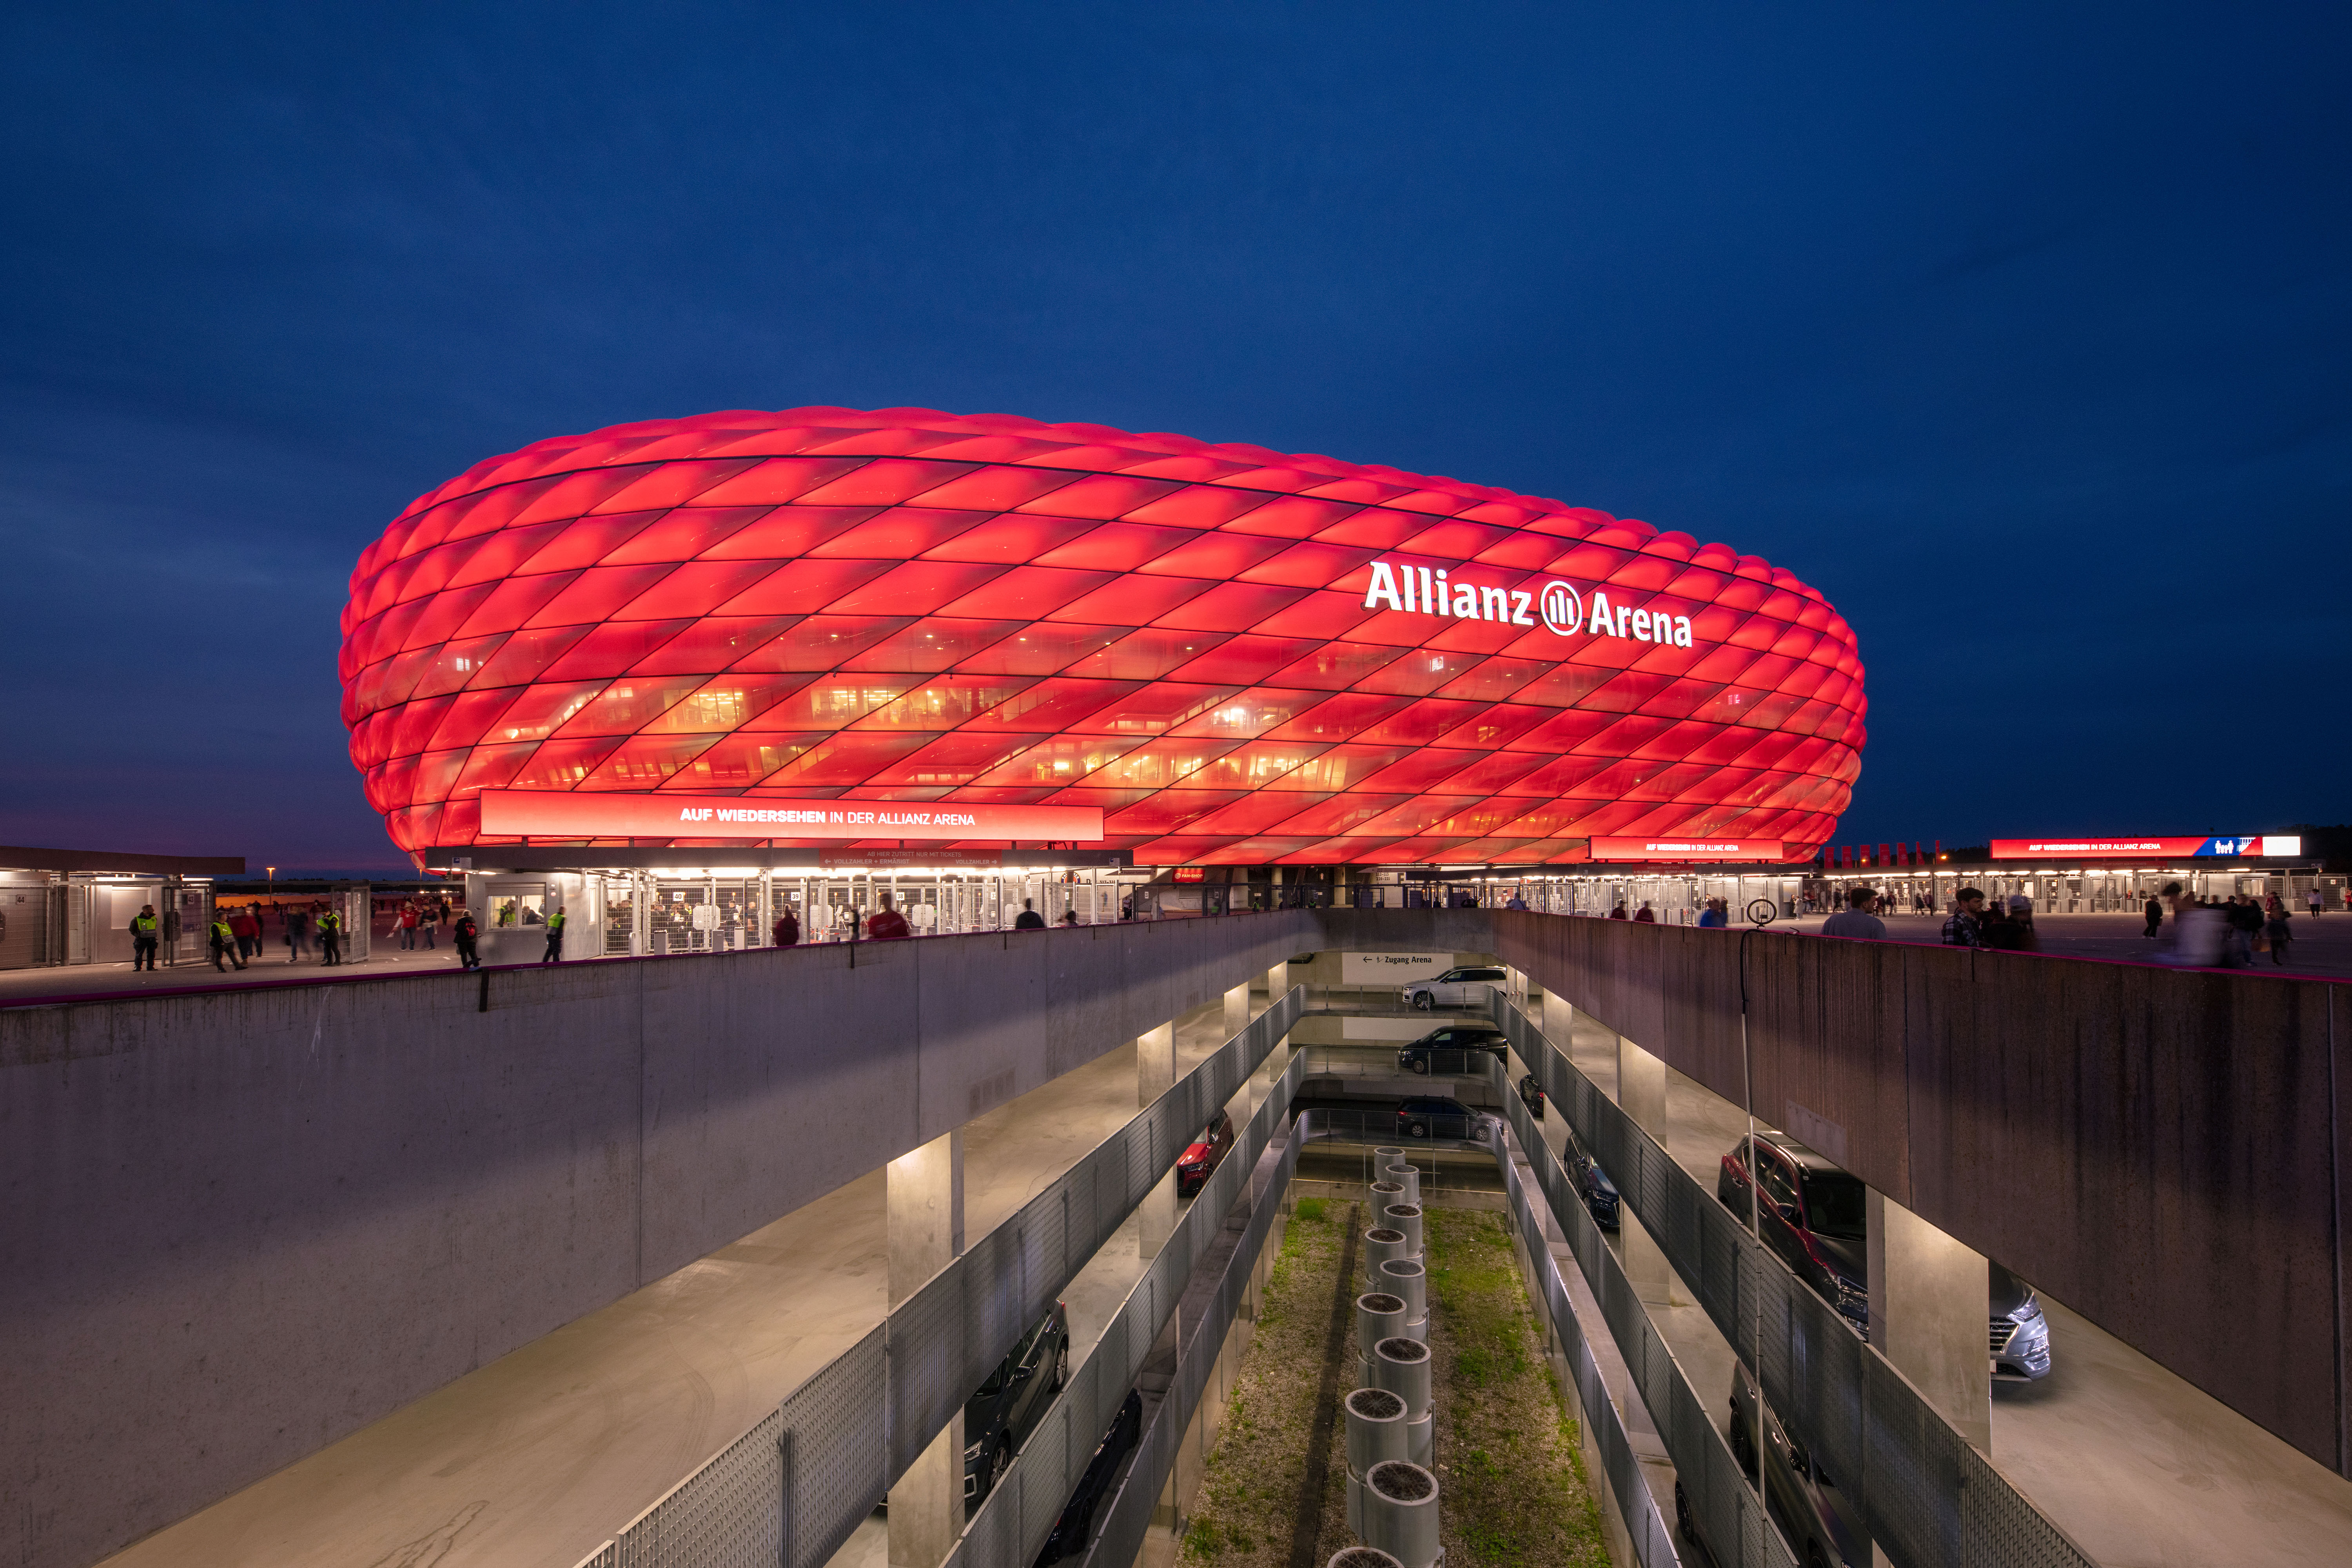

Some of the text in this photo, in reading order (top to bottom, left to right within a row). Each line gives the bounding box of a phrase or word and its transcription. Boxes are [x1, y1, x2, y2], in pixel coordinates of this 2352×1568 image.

[1365, 561, 1692, 648] Allianz Arena
[680, 808, 975, 825] AUF WIEDERSEHEN IN DER ALLIANZ ARENA
[1385, 956, 1409, 965] Zugang
